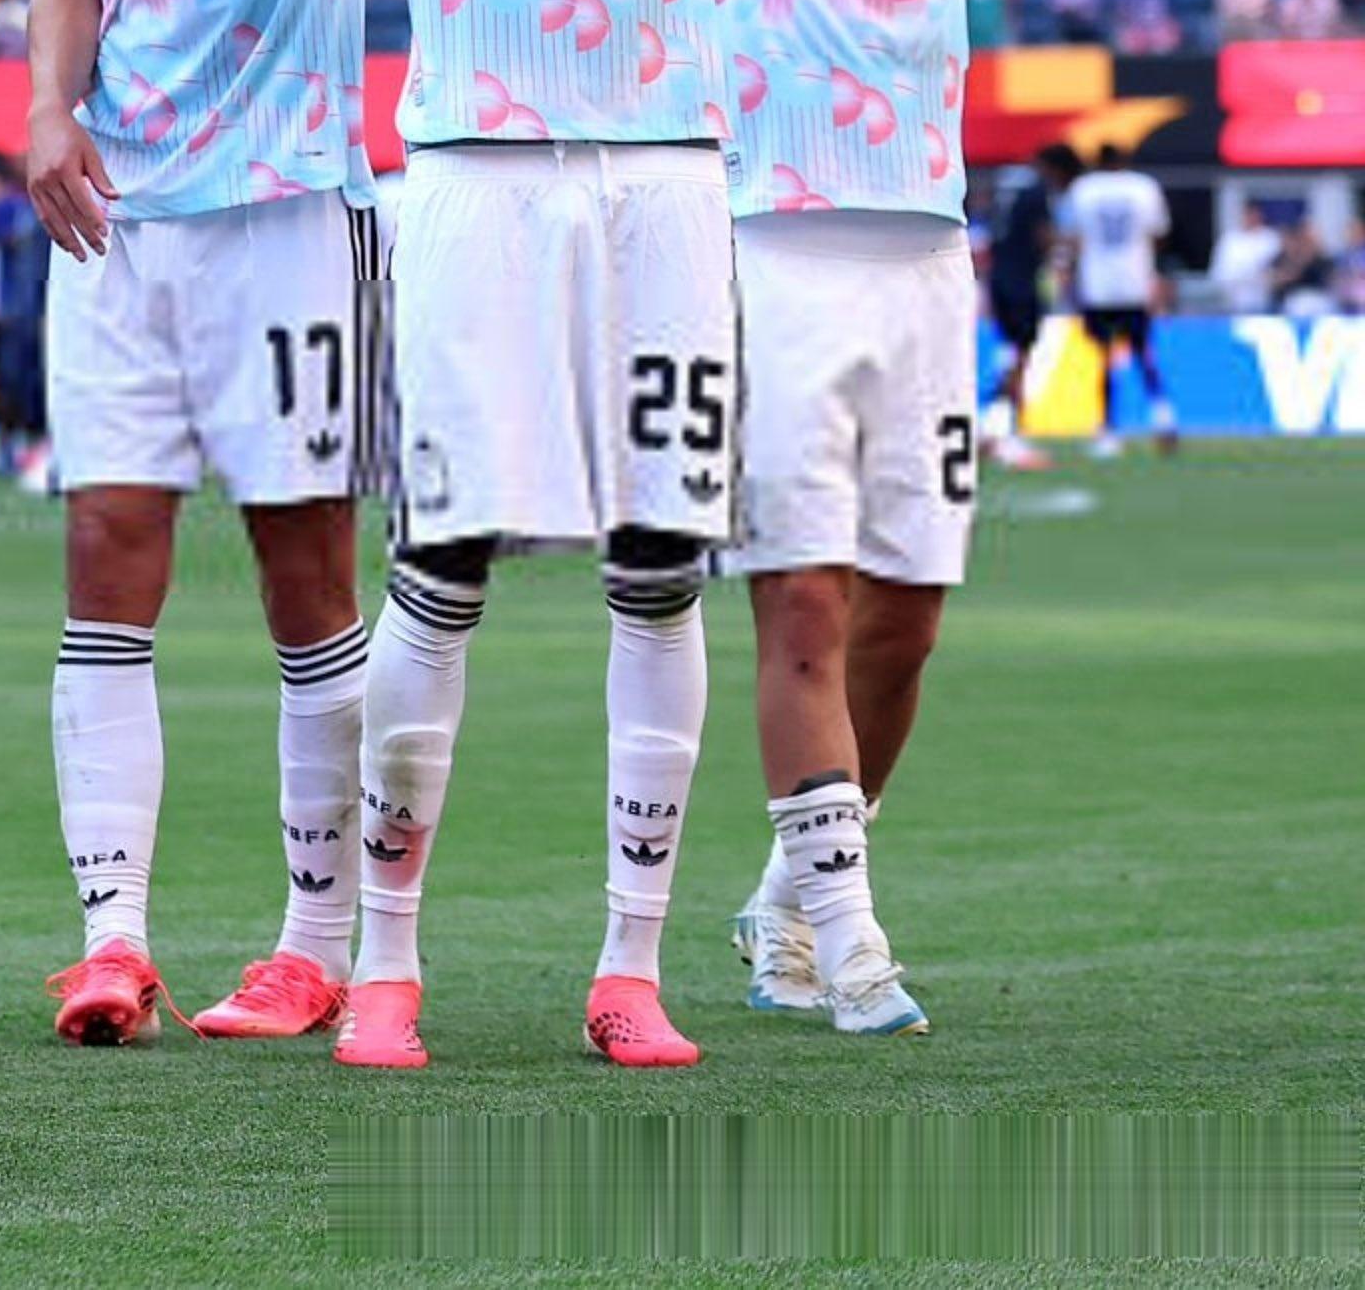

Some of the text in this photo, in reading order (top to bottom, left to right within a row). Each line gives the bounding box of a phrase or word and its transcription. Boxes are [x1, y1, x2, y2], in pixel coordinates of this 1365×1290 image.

[266, 322, 342, 417] 17
[630, 353, 724, 452] 25
[614, 795, 678, 819] RBFA
